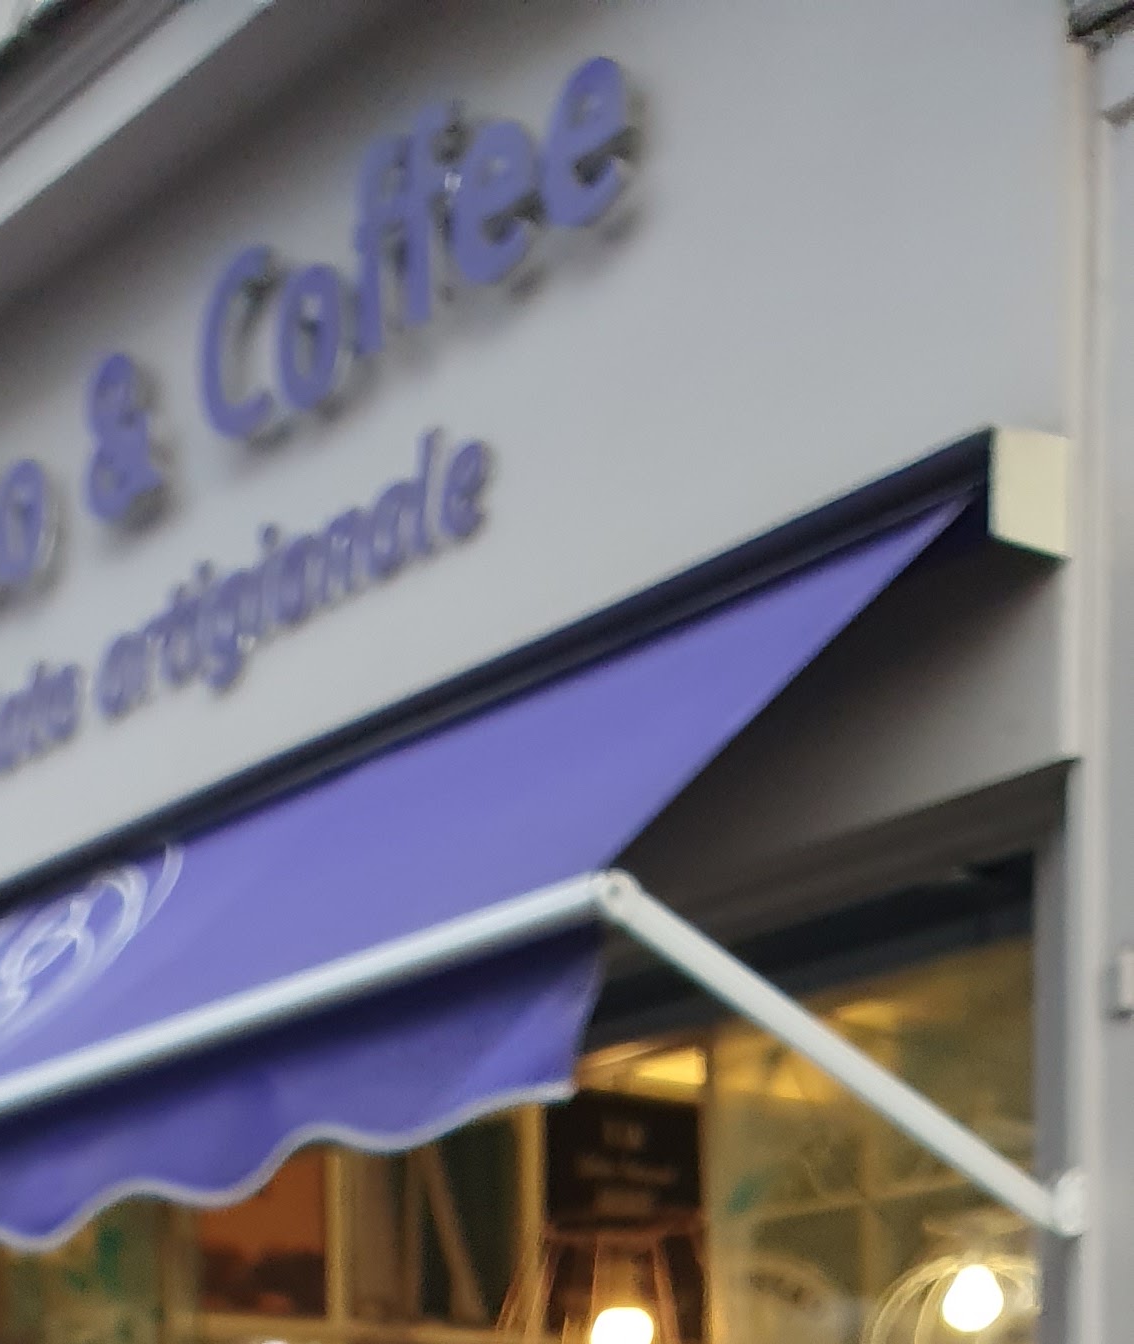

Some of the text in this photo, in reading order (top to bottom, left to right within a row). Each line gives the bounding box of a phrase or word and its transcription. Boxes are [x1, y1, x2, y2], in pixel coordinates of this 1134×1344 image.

[83, 353, 163, 522] &
[197, 56, 630, 440] Coffee
[97, 428, 488, 718] artigianale
